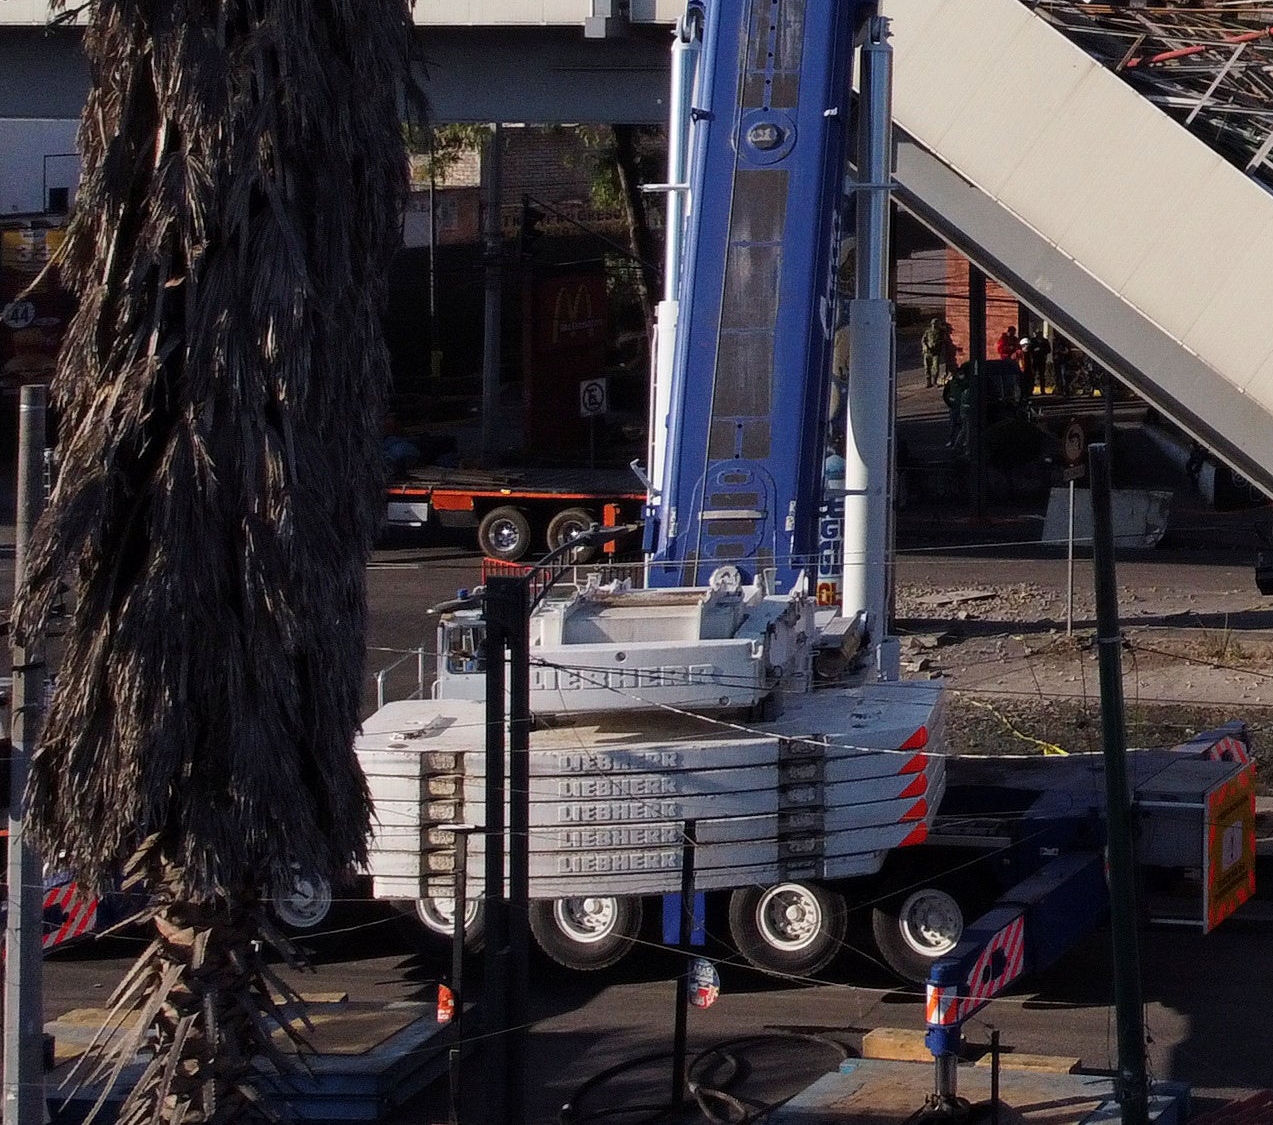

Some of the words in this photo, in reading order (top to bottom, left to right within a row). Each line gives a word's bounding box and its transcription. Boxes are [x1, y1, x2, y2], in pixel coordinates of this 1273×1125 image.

[559, 778, 679, 797] LIEBHERR
[558, 801, 679, 823] LIEBHERR
[559, 827, 680, 848] LIEBHERR
[558, 852, 679, 873] LIEBHERR
